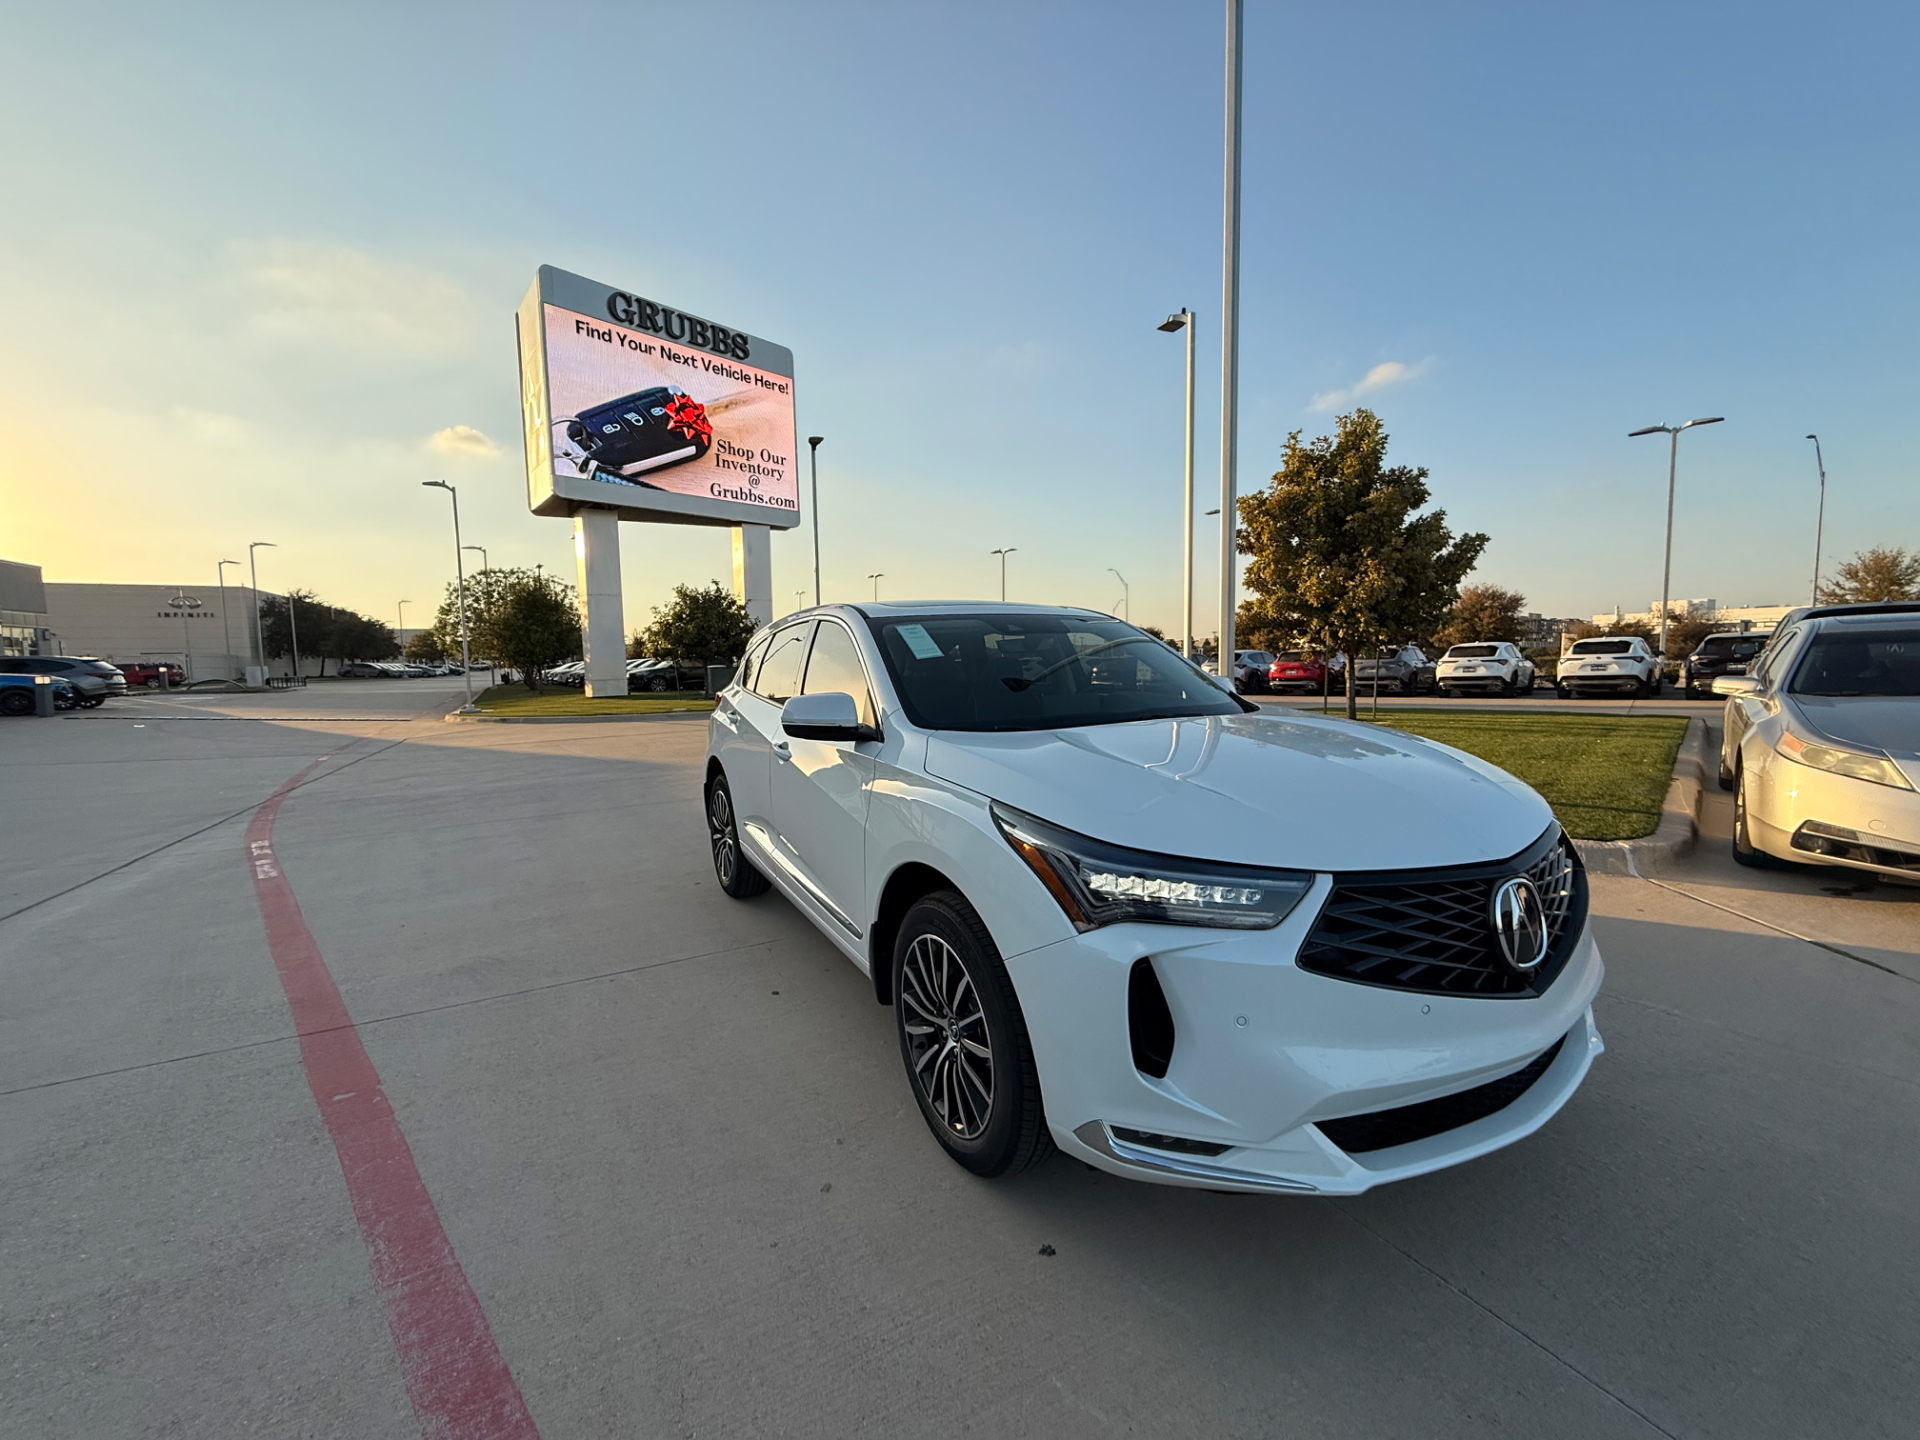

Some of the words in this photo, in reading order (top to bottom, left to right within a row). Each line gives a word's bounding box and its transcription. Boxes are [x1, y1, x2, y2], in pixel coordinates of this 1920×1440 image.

[607, 291, 750, 360] GRUBBS
[575, 319, 612, 344] Find
[616, 331, 656, 355] Your
[660, 345, 698, 369] Next
[701, 357, 752, 383] Vehicle
[754, 373, 789, 395] Here!
[717, 438, 755, 462] Shop
[760, 448, 787, 466] Our
[714, 452, 784, 481] Inventory
[710, 482, 796, 509] Grubbs.com
[748, 474, 761, 489] @
